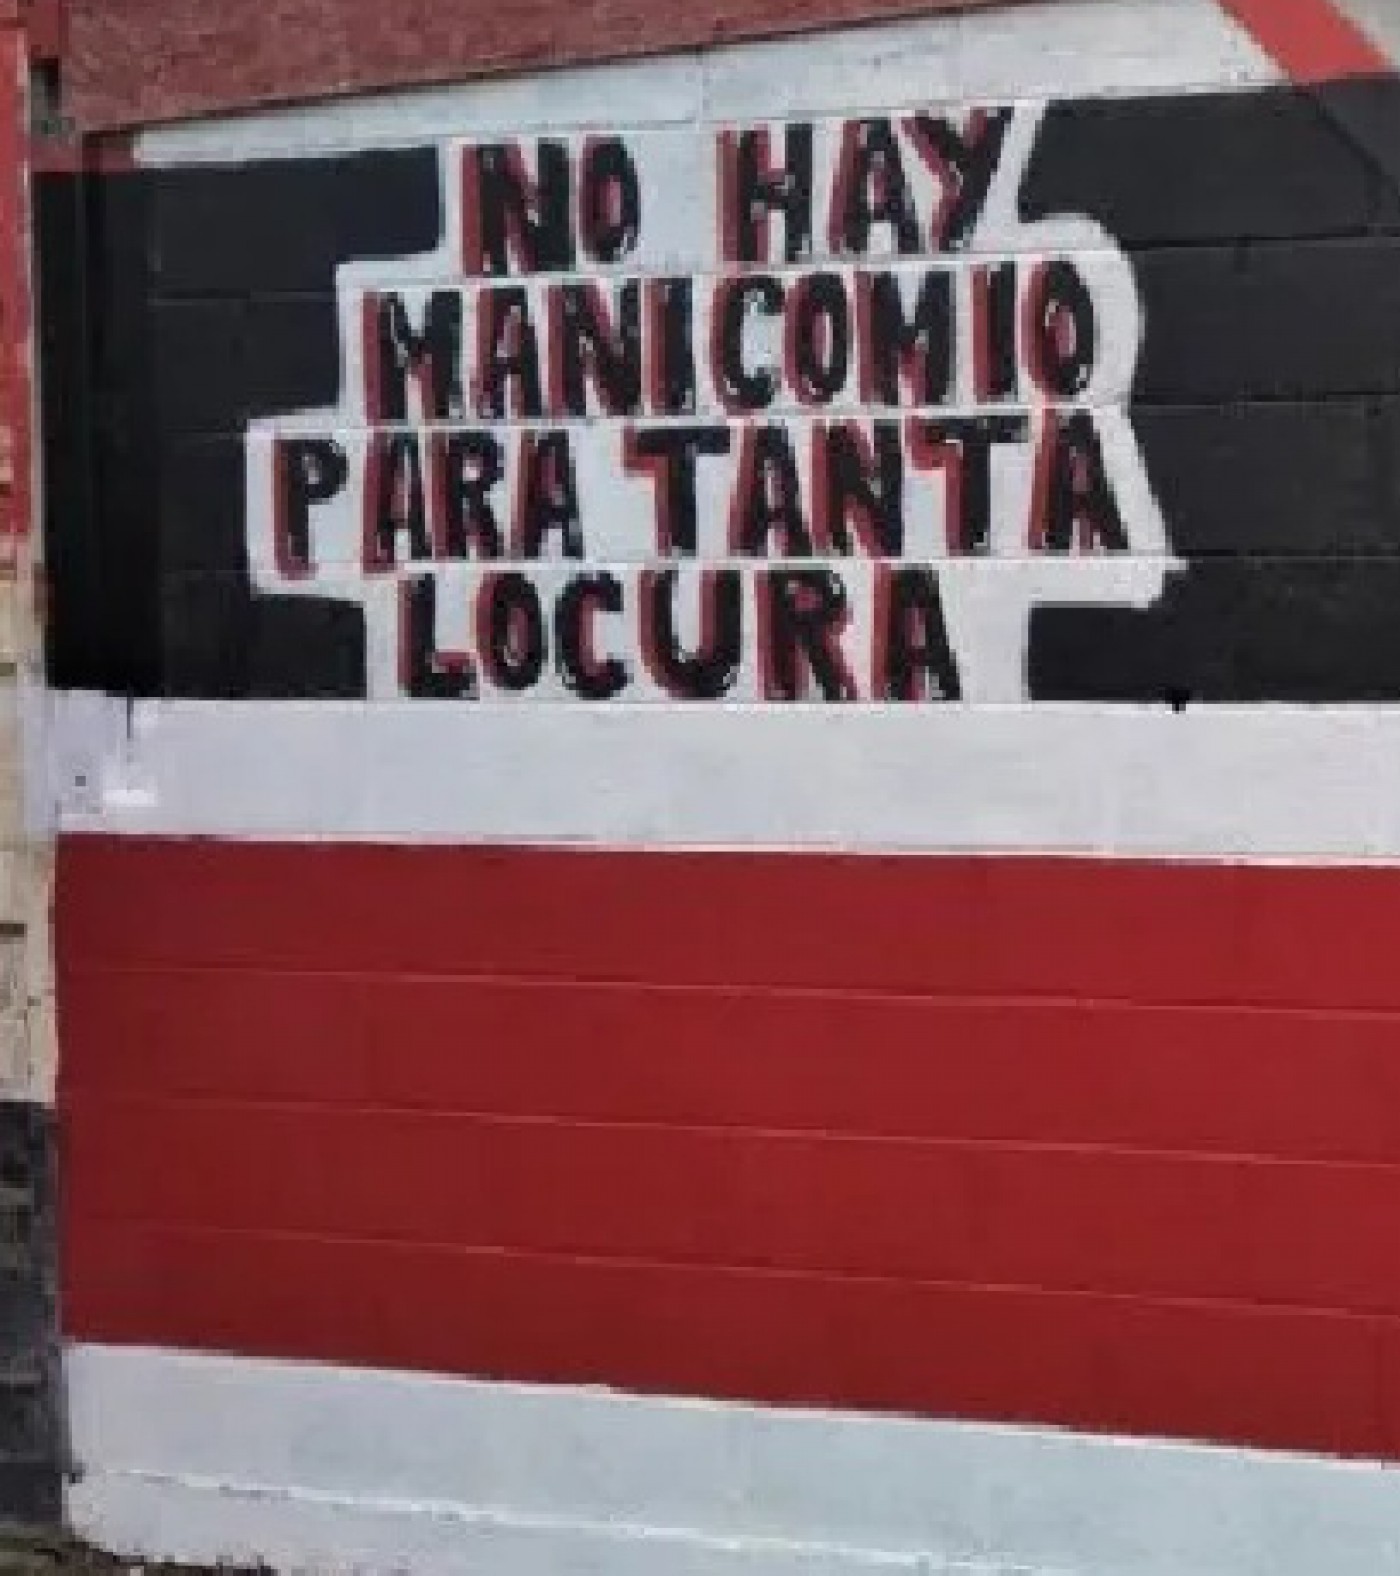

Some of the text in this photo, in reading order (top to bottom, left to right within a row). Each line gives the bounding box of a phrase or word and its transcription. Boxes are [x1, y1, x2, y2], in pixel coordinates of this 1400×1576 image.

[458, 105, 1012, 276] NO HAY
[361, 260, 1094, 421] MANICOMIO
[272, 409, 1129, 579] PARA TANTA
[398, 563, 962, 701] LOCURA
